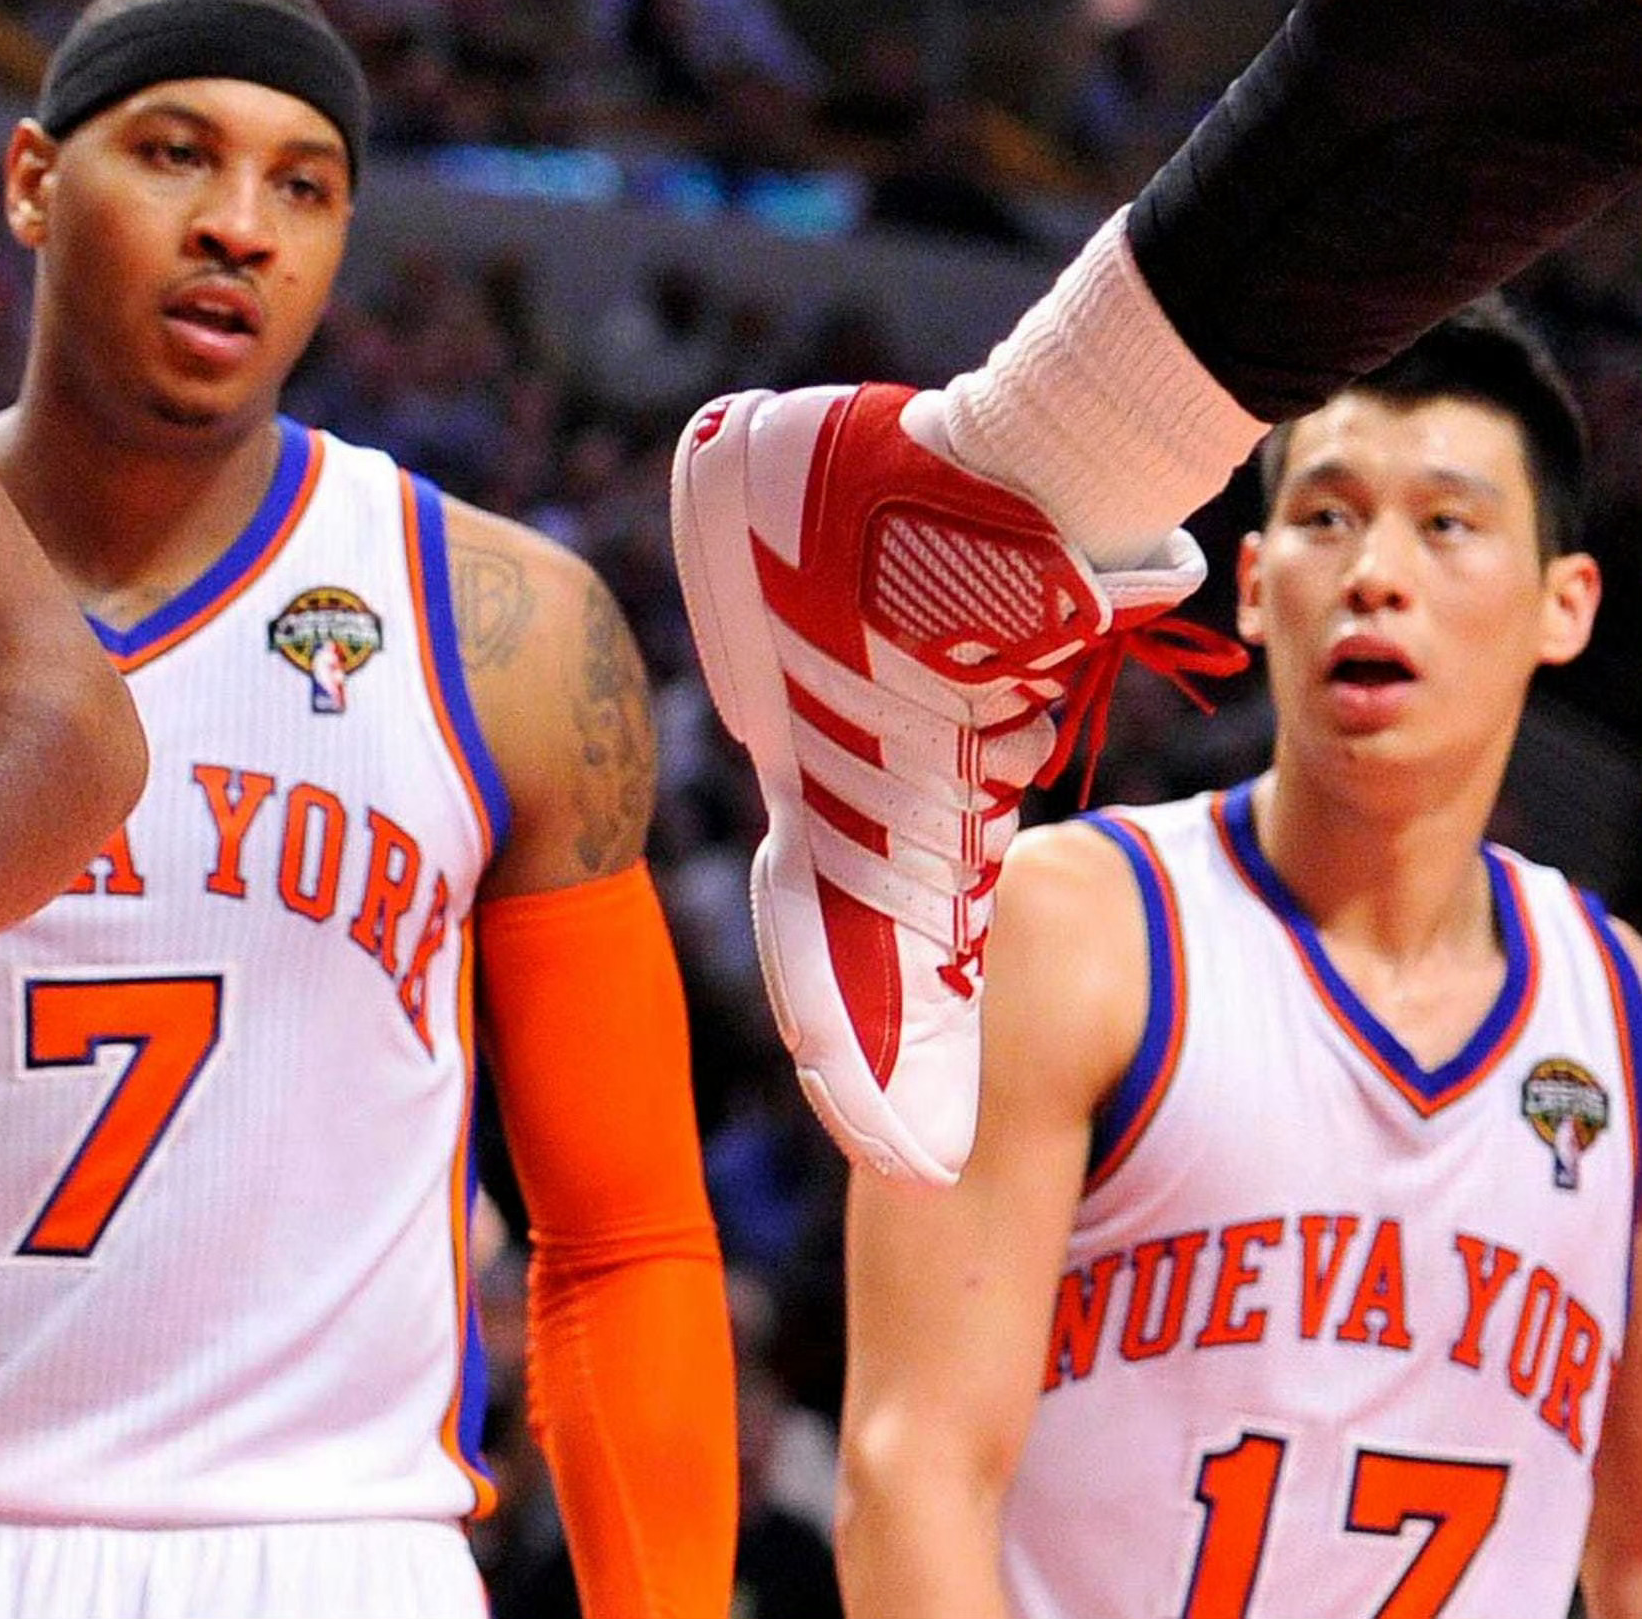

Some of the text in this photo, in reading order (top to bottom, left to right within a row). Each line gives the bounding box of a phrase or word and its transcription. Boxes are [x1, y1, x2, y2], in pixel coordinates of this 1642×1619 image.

[13, 973, 225, 1259] 7
[1040, 1214, 1598, 1456] NUEVA YOR
[1180, 1430, 1515, 1619] 17
